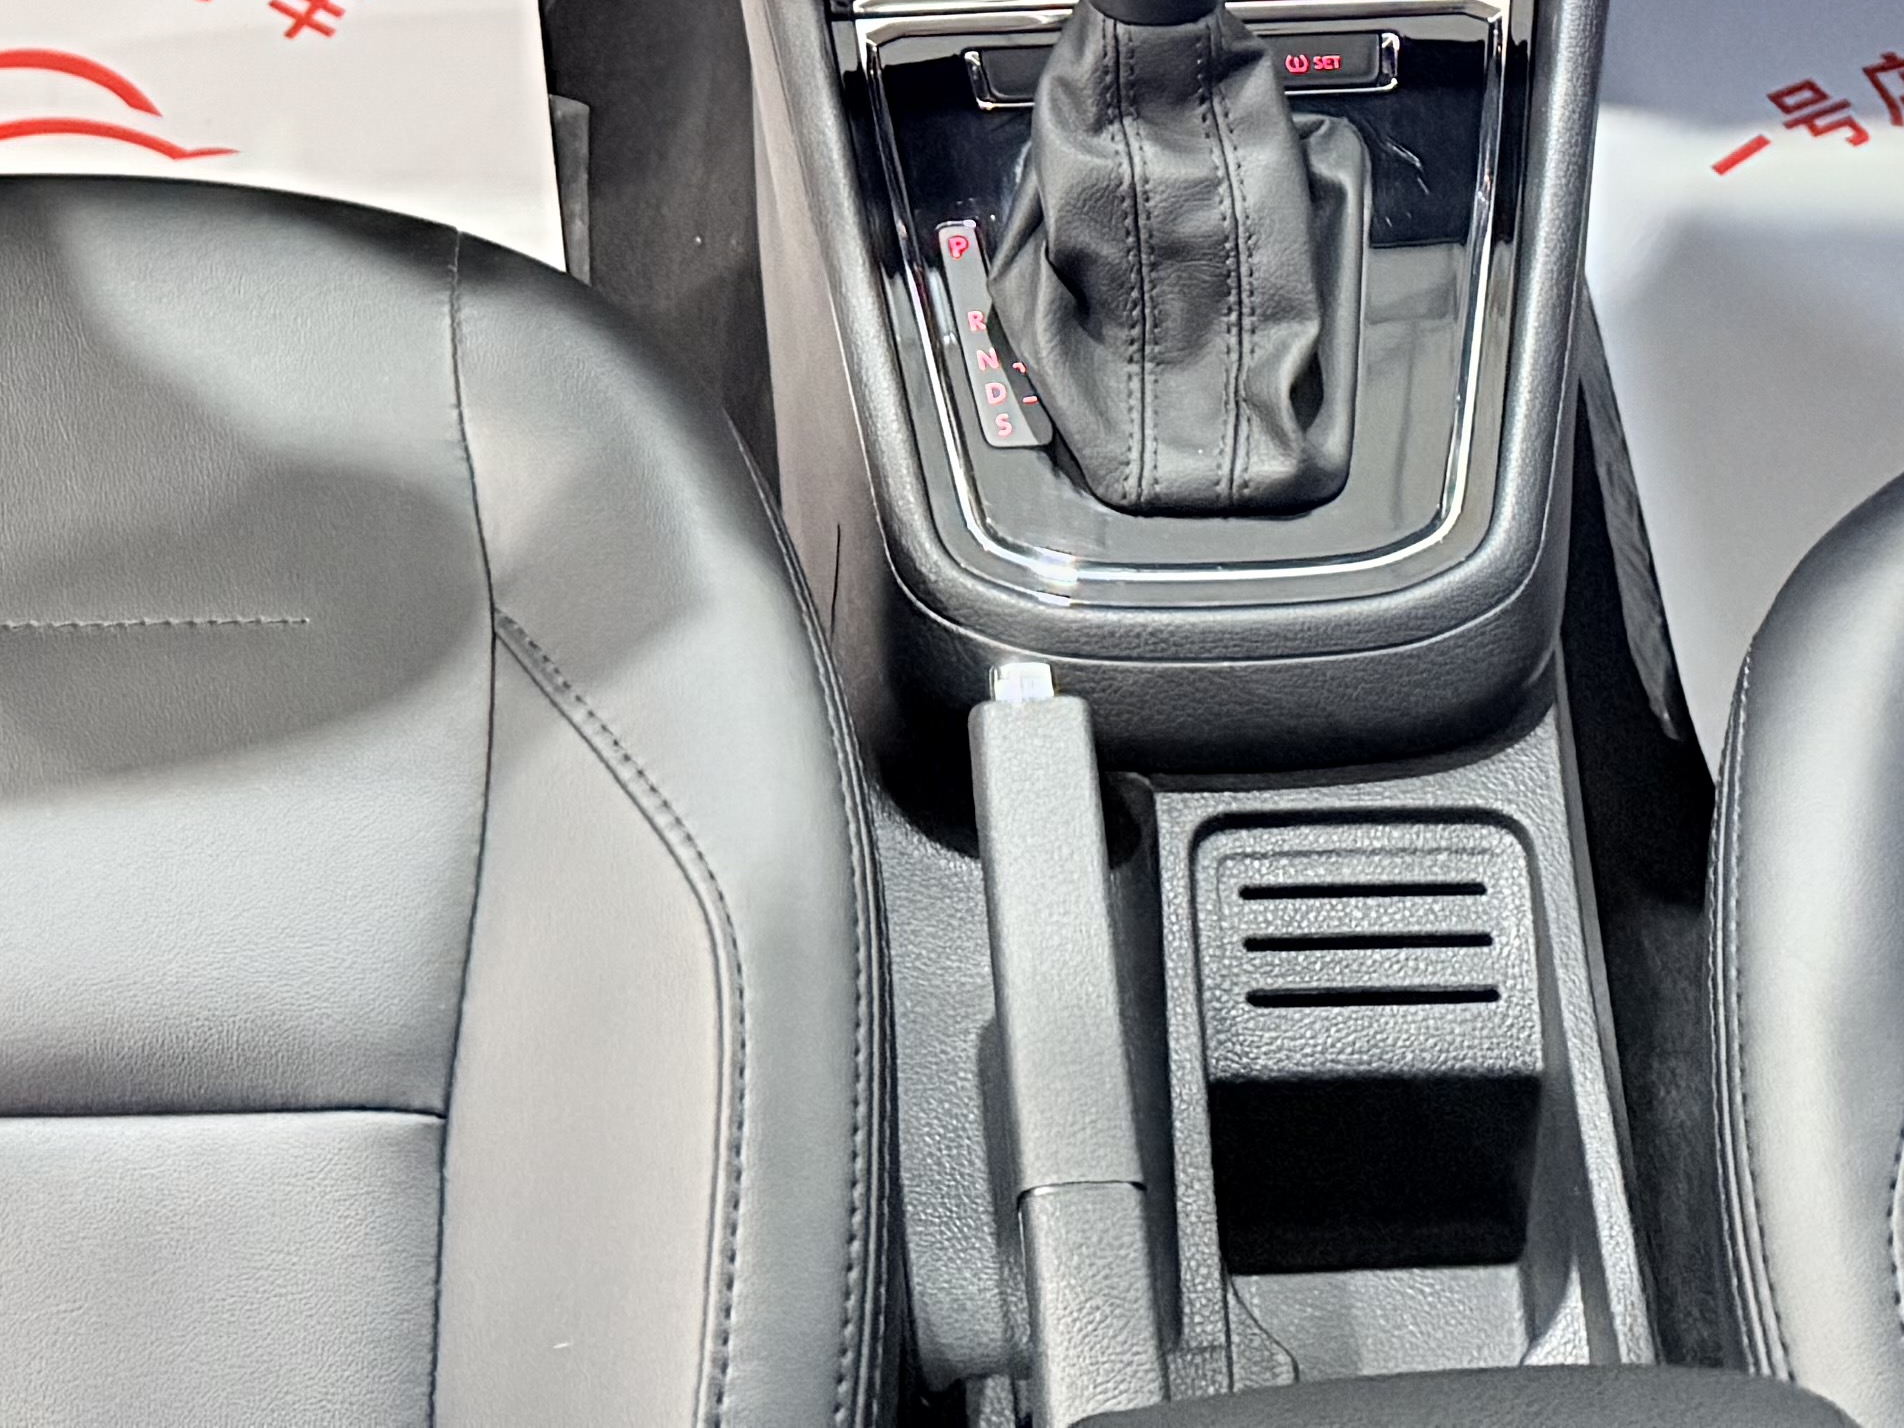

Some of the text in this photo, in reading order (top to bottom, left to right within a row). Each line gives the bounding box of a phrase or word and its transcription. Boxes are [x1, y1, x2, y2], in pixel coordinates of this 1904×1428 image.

[1313, 53, 1341, 71] SET
[947, 235, 970, 260] P
[967, 310, 987, 332] R
[976, 346, 1001, 371] N
[984, 382, 1007, 406] D
[995, 413, 1013, 437] S
